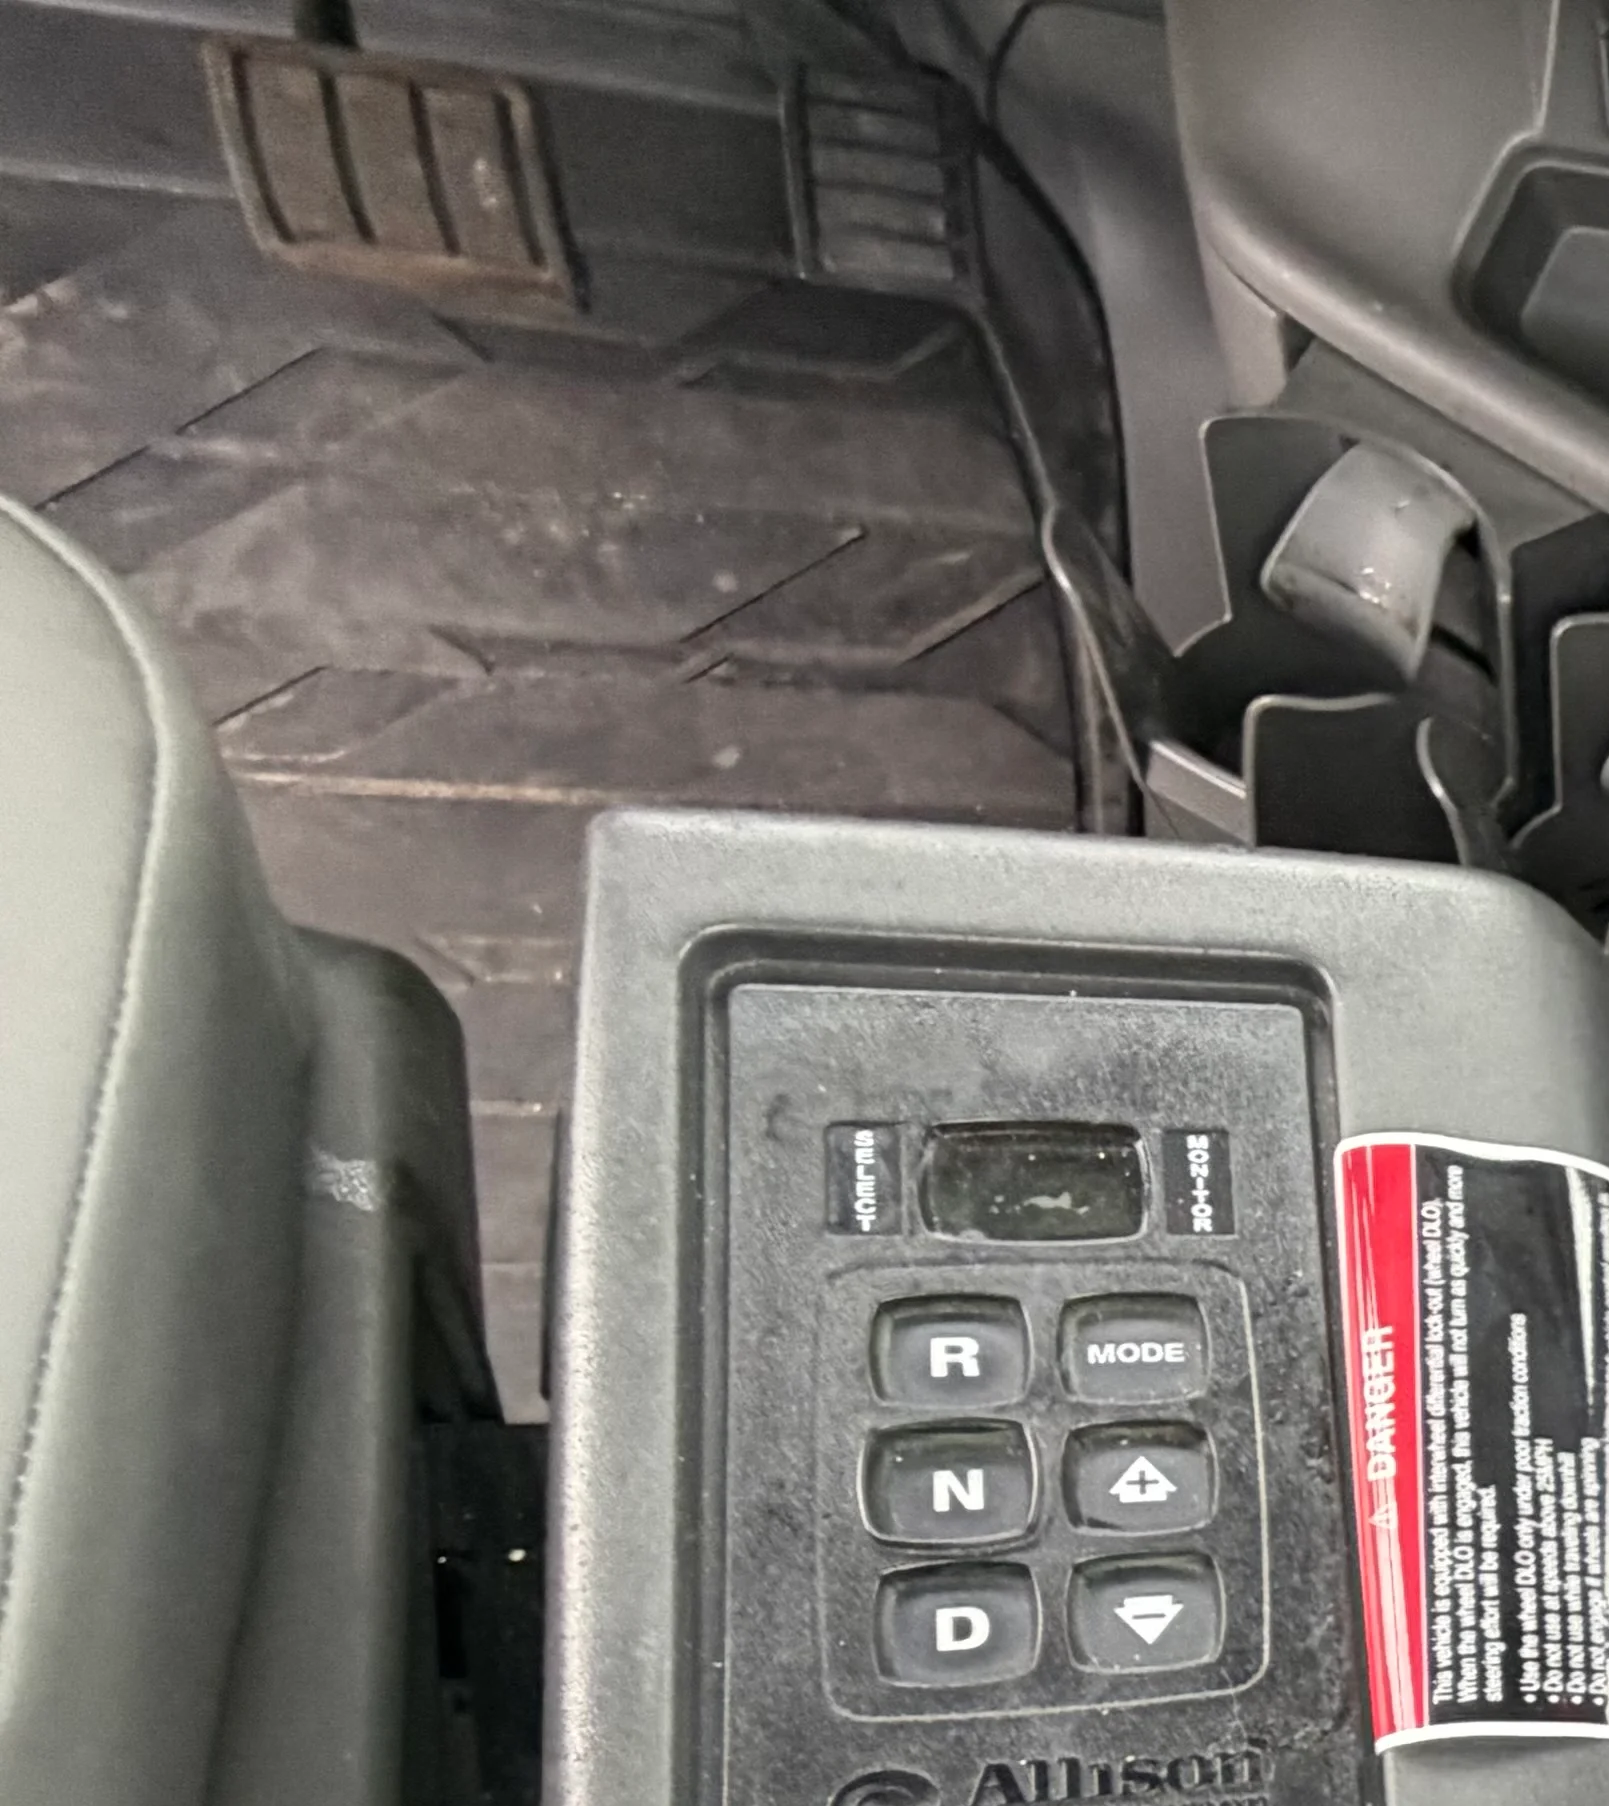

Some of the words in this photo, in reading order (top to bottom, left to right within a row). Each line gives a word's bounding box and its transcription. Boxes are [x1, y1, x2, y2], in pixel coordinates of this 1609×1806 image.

[854, 1130, 873, 1232] SELECT
[1187, 1135, 1213, 1232] MONITOR
[1445, 1165, 1464, 1199] more
[1445, 1201, 1465, 1228] and
[1446, 1230, 1470, 1276] quickly
[1449, 1279, 1466, 1296] as
[1423, 1288, 1444, 1341] lock-out
[1448, 1298, 1467, 1325] turn
[929, 1336, 980, 1378] R
[1086, 1342, 1186, 1364] MODE
[1449, 1328, 1468, 1350] not
[1507, 1313, 1529, 1382] conditions
[1424, 1344, 1447, 1416] differential
[1449, 1353, 1469, 1376] will
[1362, 1325, 1398, 1480] DANGER
[1450, 1379, 1471, 1428] vehicle
[1509, 1385, 1530, 1436] traction
[1426, 1419, 1447, 1491] interwheel
[1452, 1431, 1472, 1457] this
[1513, 1438, 1536, 1471] poor
[1534, 1437, 1555, 1492] 25MPH
[1557, 1451, 1577, 1509] downhill
[1581, 1437, 1600, 1495] spinning
[932, 1469, 985, 1513] N
[1513, 1473, 1533, 1514] under
[1429, 1495, 1447, 1524] with
[1476, 1484, 1501, 1547] required.
[1537, 1495, 1556, 1537] above
[1585, 1499, 1599, 1522] are
[1453, 1530, 1473, 1542] is
[1515, 1516, 1538, 1548] only
[1560, 1512, 1583, 1571] traveling
[1584, 1525, 1601, 1573] wheels
[1430, 1527, 1454, 1595] equipped
[1453, 1546, 1474, 1580] DLO
[1478, 1550, 1498, 1569] be
[1514, 1550, 1536, 1585] DLO
[1539, 1540, 1562, 1592] speeds
[1479, 1573, 1499, 1596] will
[1541, 1595, 1559, 1609] at
[1562, 1574, 1582, 1611] while
[1431, 1599, 1450, 1612] is
[1455, 1583, 1475, 1627] wheel
[1480, 1599, 1501, 1638] effort
[1516, 1587, 1537, 1630] wheel
[935, 1607, 989, 1653] D
[1431, 1615, 1452, 1667] vehicle
[1456, 1630, 1476, 1653] the
[1543, 1613, 1561, 1639] use
[1566, 1615, 1583, 1641] use
[1518, 1634, 1538, 1657] the
[1542, 1643, 1561, 1666] not
[1565, 1643, 1584, 1667] not
[1432, 1670, 1453, 1703] This
[1457, 1657, 1478, 1703] When
[1482, 1641, 1507, 1702] steering
[1518, 1661, 1539, 1691] Use
[1543, 1670, 1563, 1692] Do
[1566, 1671, 1585, 1693] Do
[1589, 1672, 1607, 1694] Do
